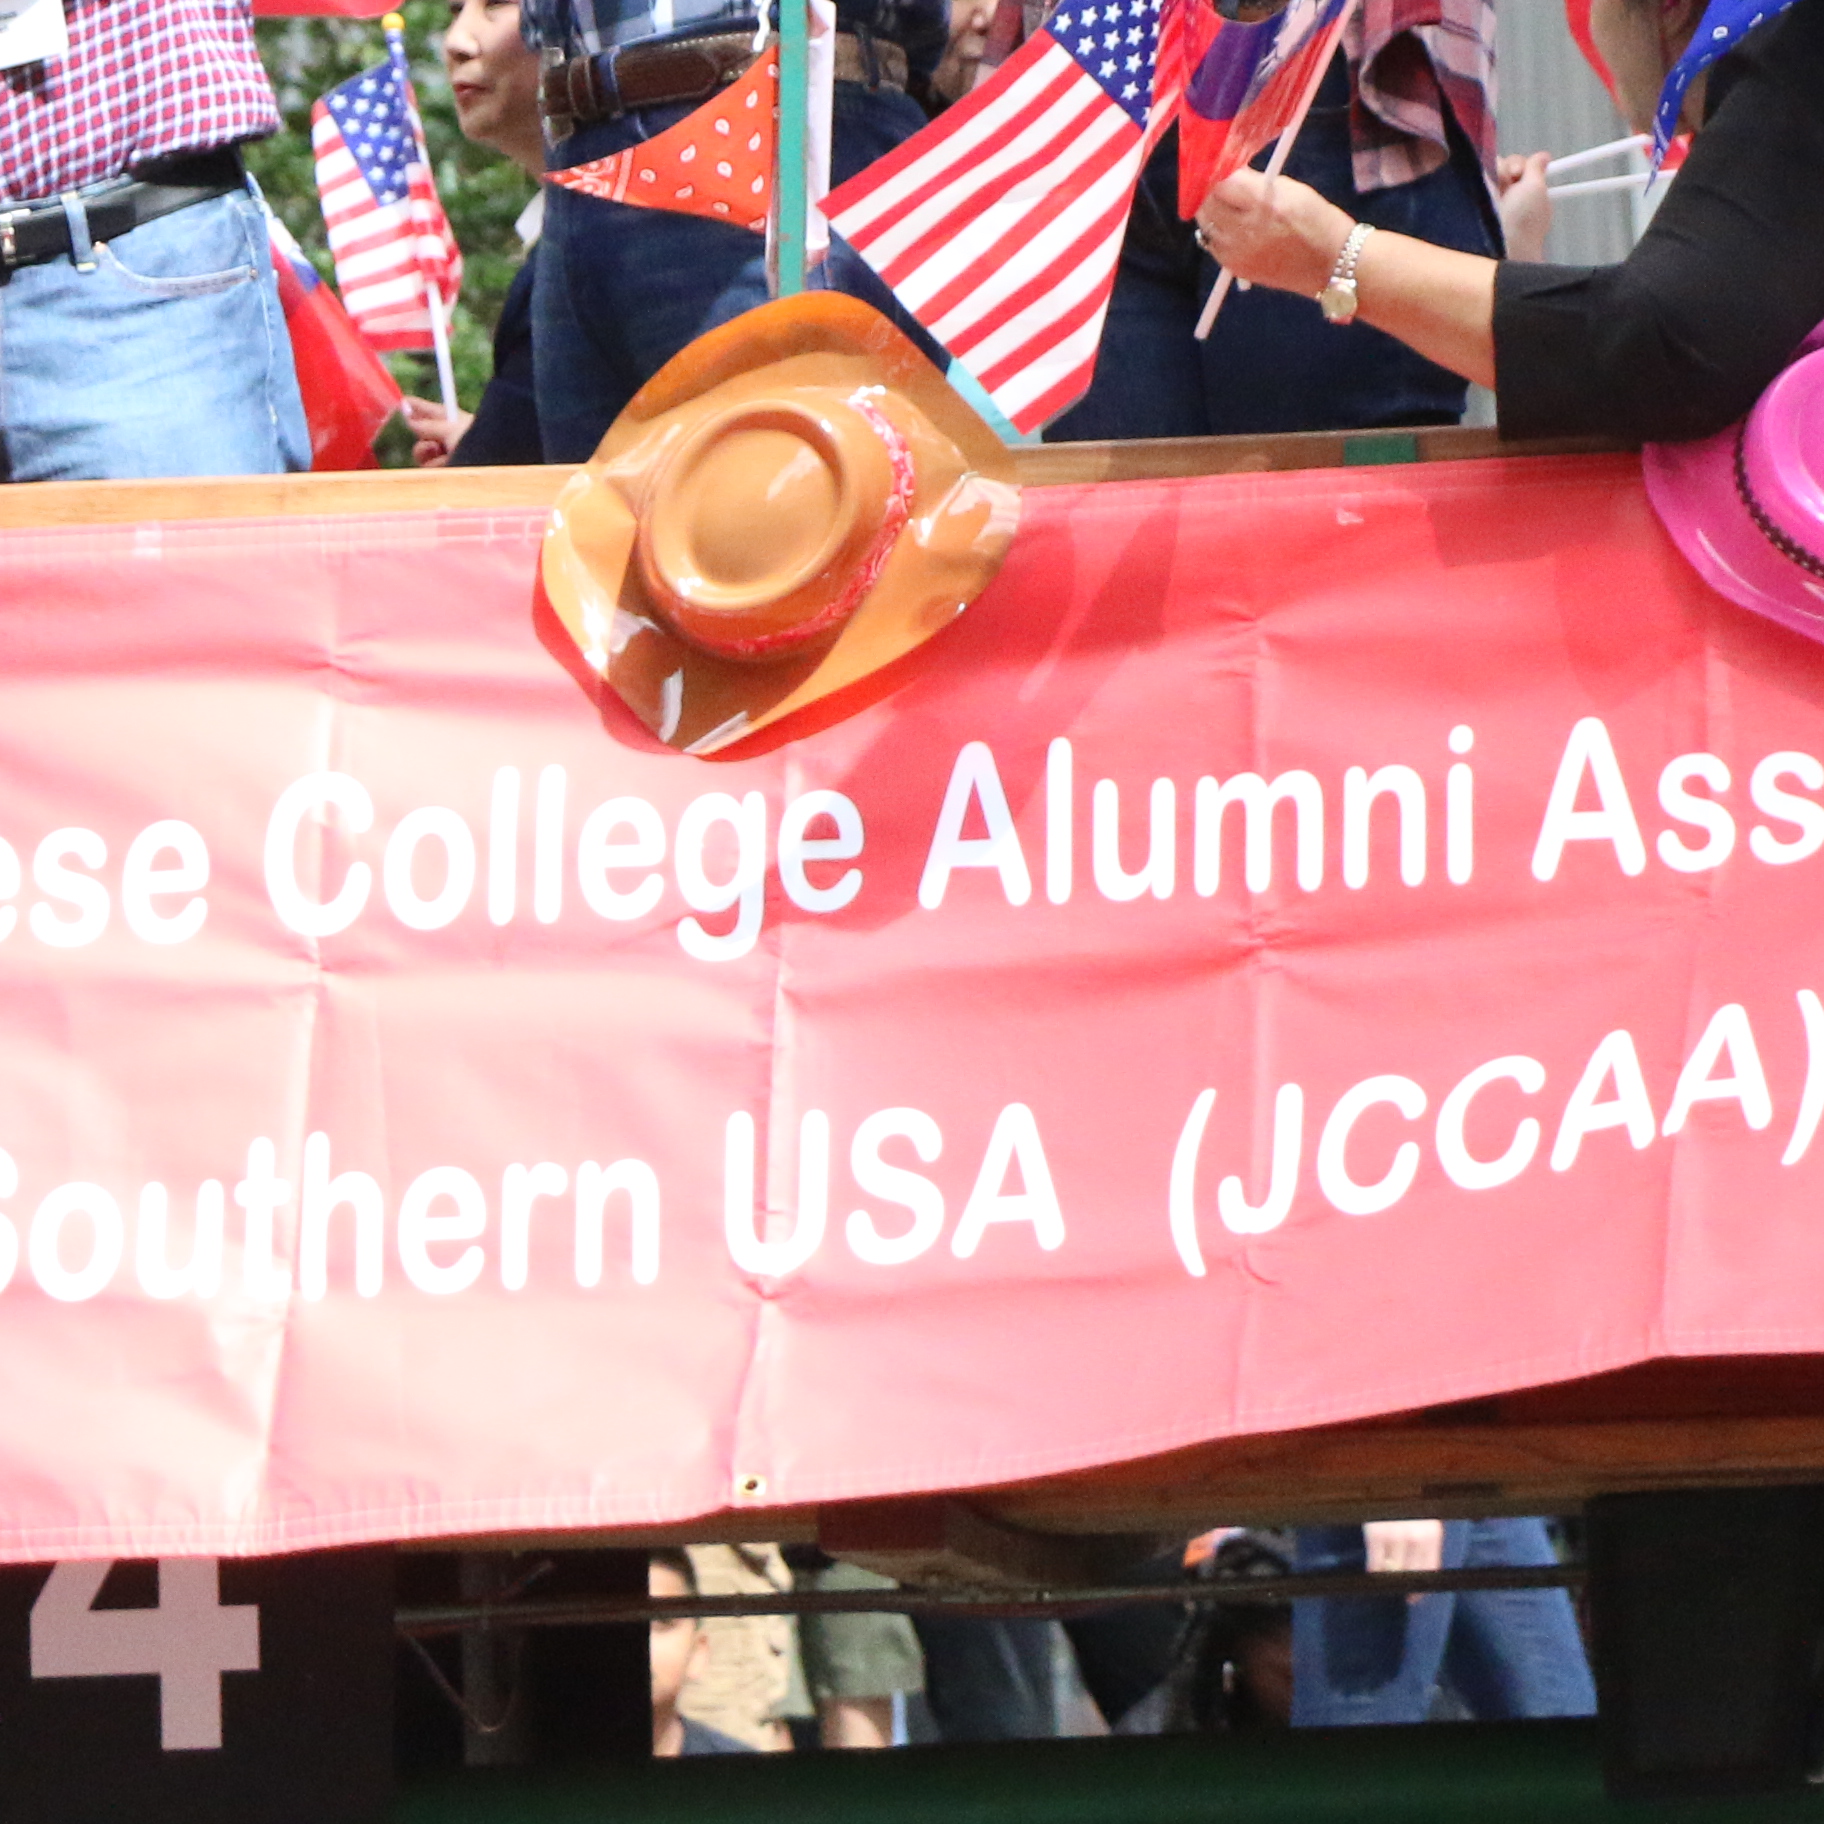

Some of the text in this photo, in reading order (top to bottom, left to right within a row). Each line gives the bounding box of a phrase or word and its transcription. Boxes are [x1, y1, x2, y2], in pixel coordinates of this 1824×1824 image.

[262, 763, 866, 963] College
[917, 726, 1475, 910] Alumni
[723, 1101, 1067, 1280] USA
[30, 1556, 261, 1750] 4
